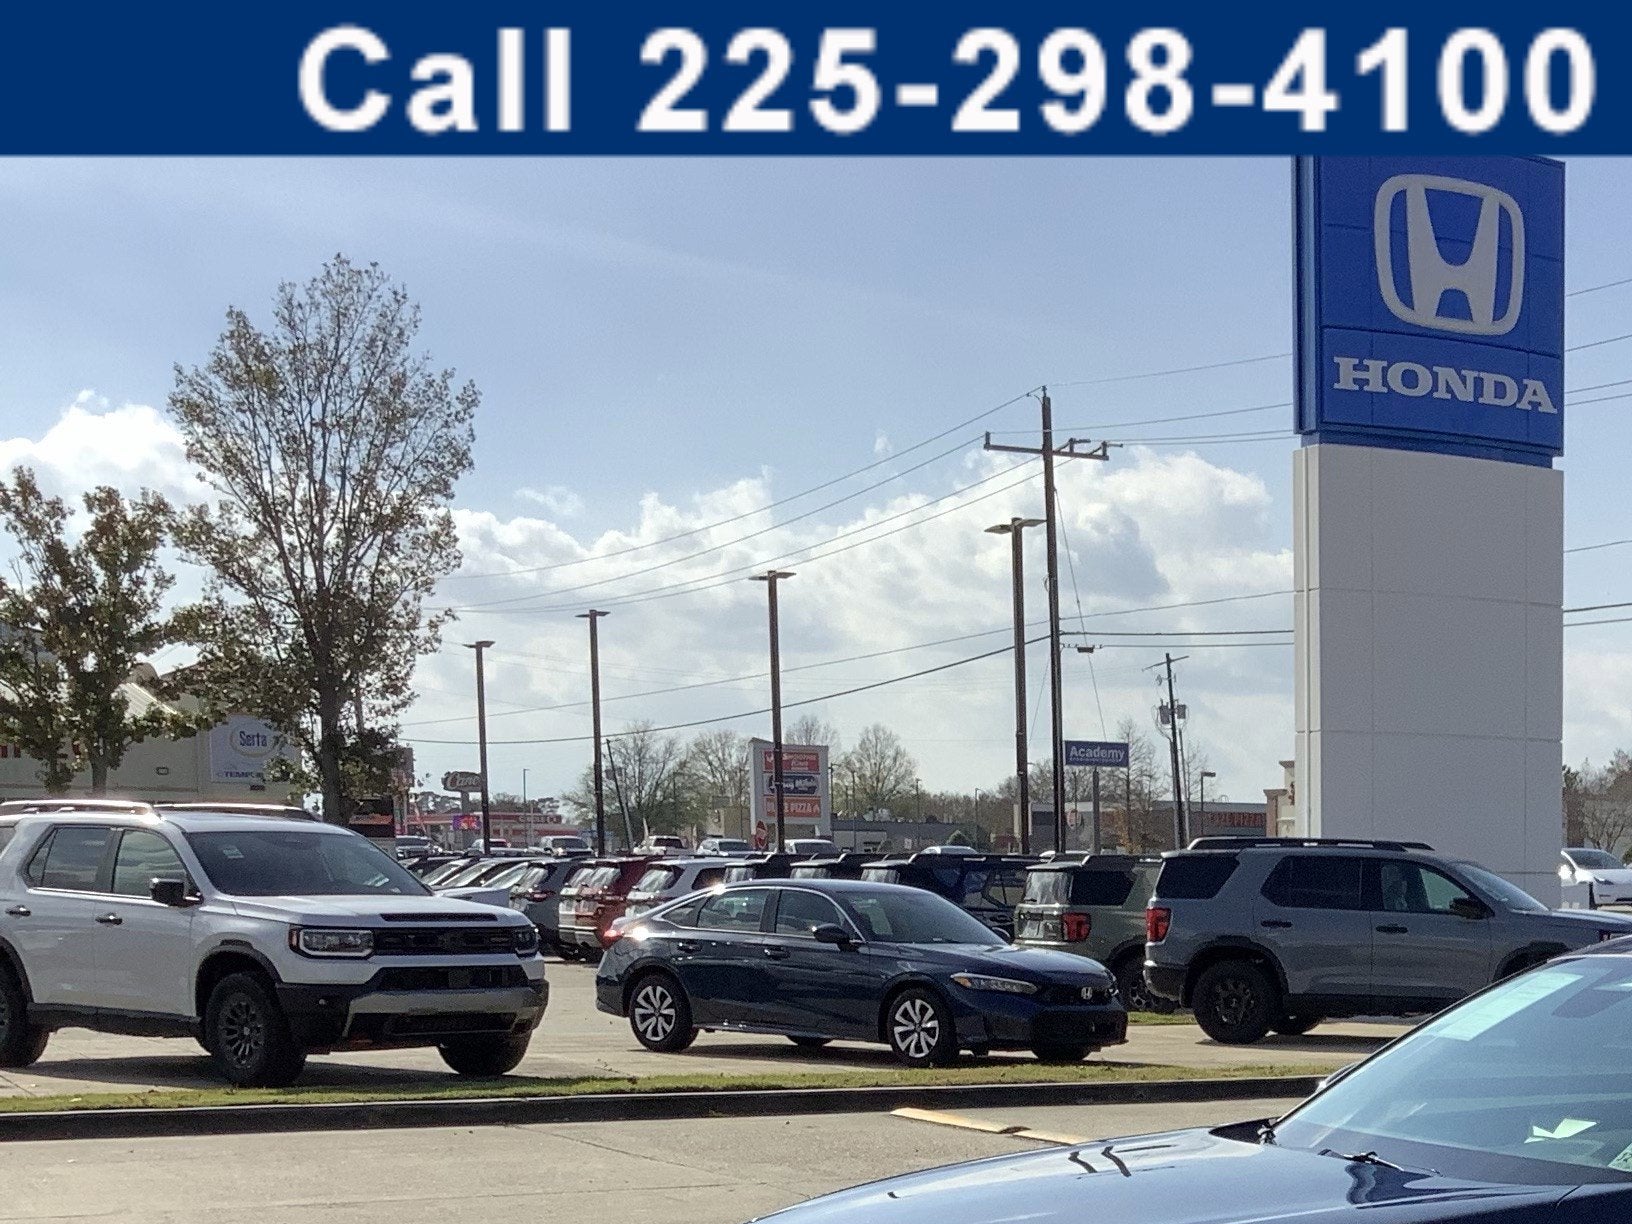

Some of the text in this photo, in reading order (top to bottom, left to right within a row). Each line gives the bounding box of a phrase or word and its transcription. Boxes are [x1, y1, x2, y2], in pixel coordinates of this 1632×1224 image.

[1333, 356, 1558, 414] HONDA
[239, 730, 268, 747] Serta
[1069, 745, 1125, 762] Academy
[446, 771, 482, 790] Cane
